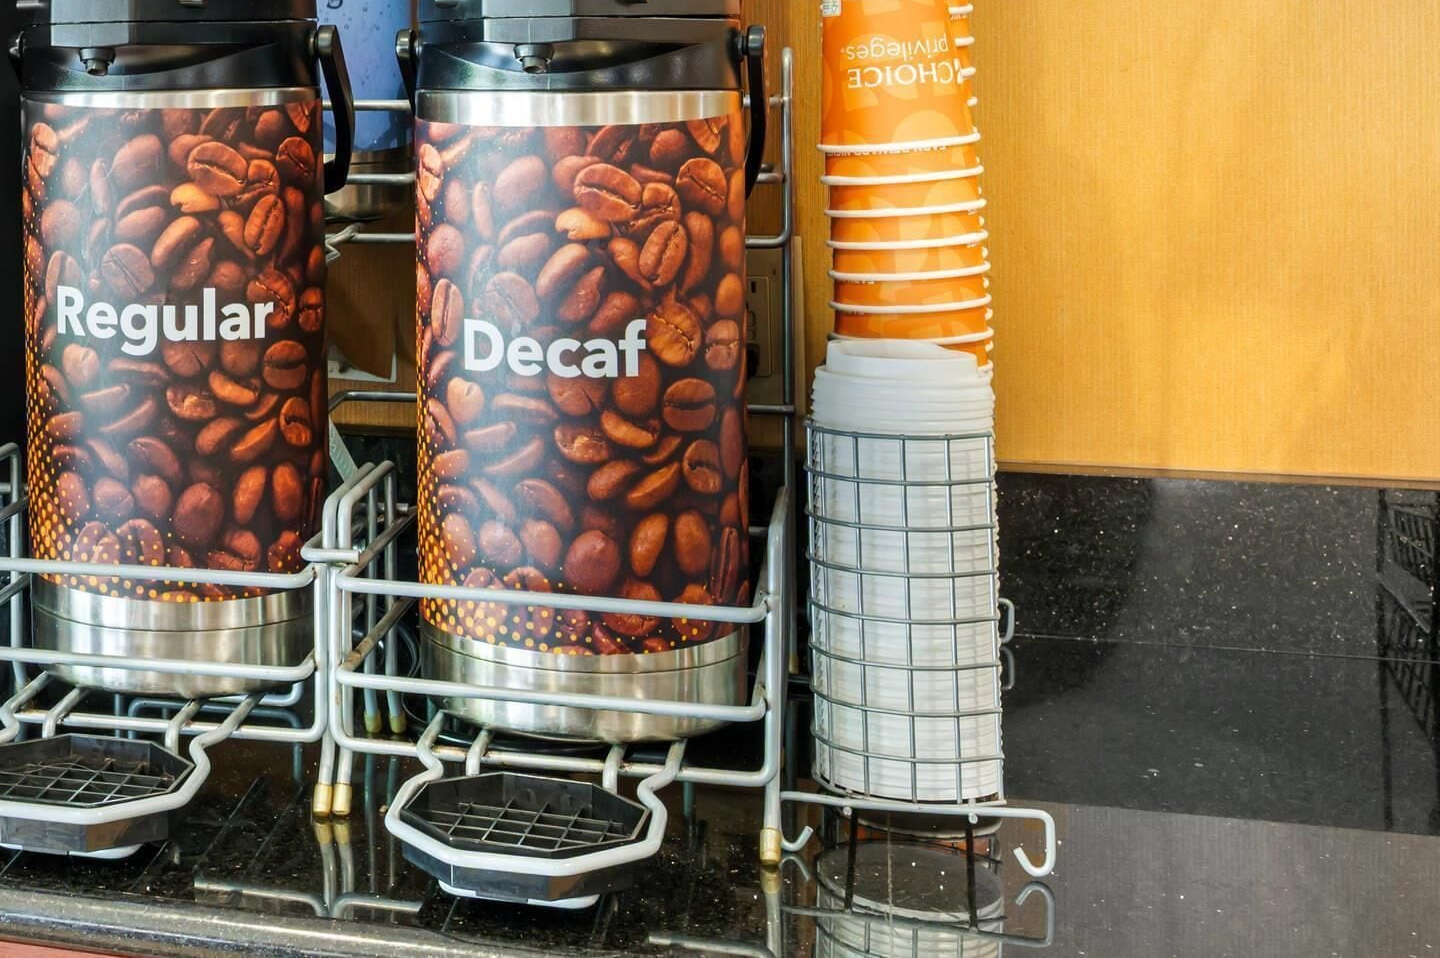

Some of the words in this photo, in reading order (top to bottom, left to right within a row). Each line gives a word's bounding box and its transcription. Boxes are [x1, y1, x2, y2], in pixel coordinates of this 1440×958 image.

[846, 34, 949, 61] privileges
[848, 62, 953, 88] CHOICE
[56, 285, 274, 356] Regular
[464, 318, 647, 378] Decaf
